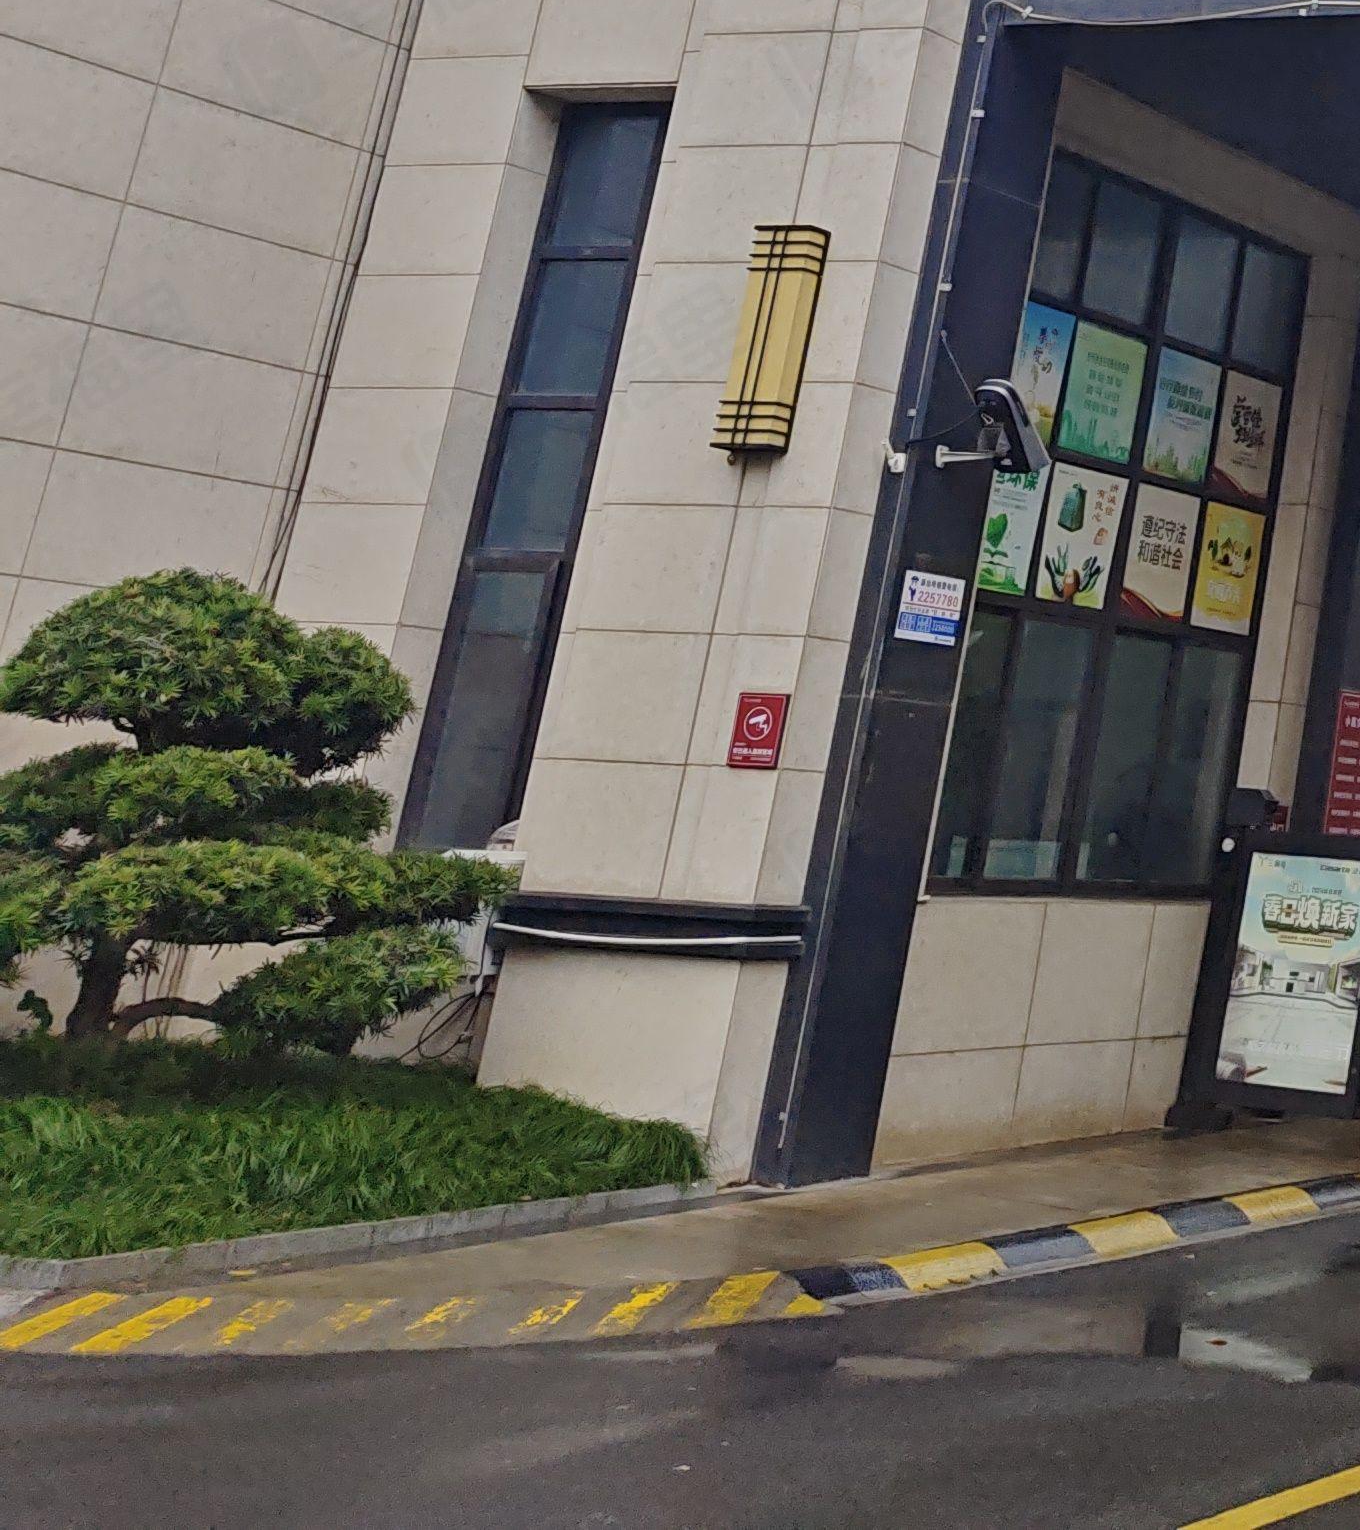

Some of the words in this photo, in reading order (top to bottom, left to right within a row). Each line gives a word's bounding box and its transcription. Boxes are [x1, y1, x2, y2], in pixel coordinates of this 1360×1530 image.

[1141, 515, 1187, 545] 遵纪守法
[1137, 540, 1183, 570] 和谐社会
[918, 591, 959, 608] 2257780
